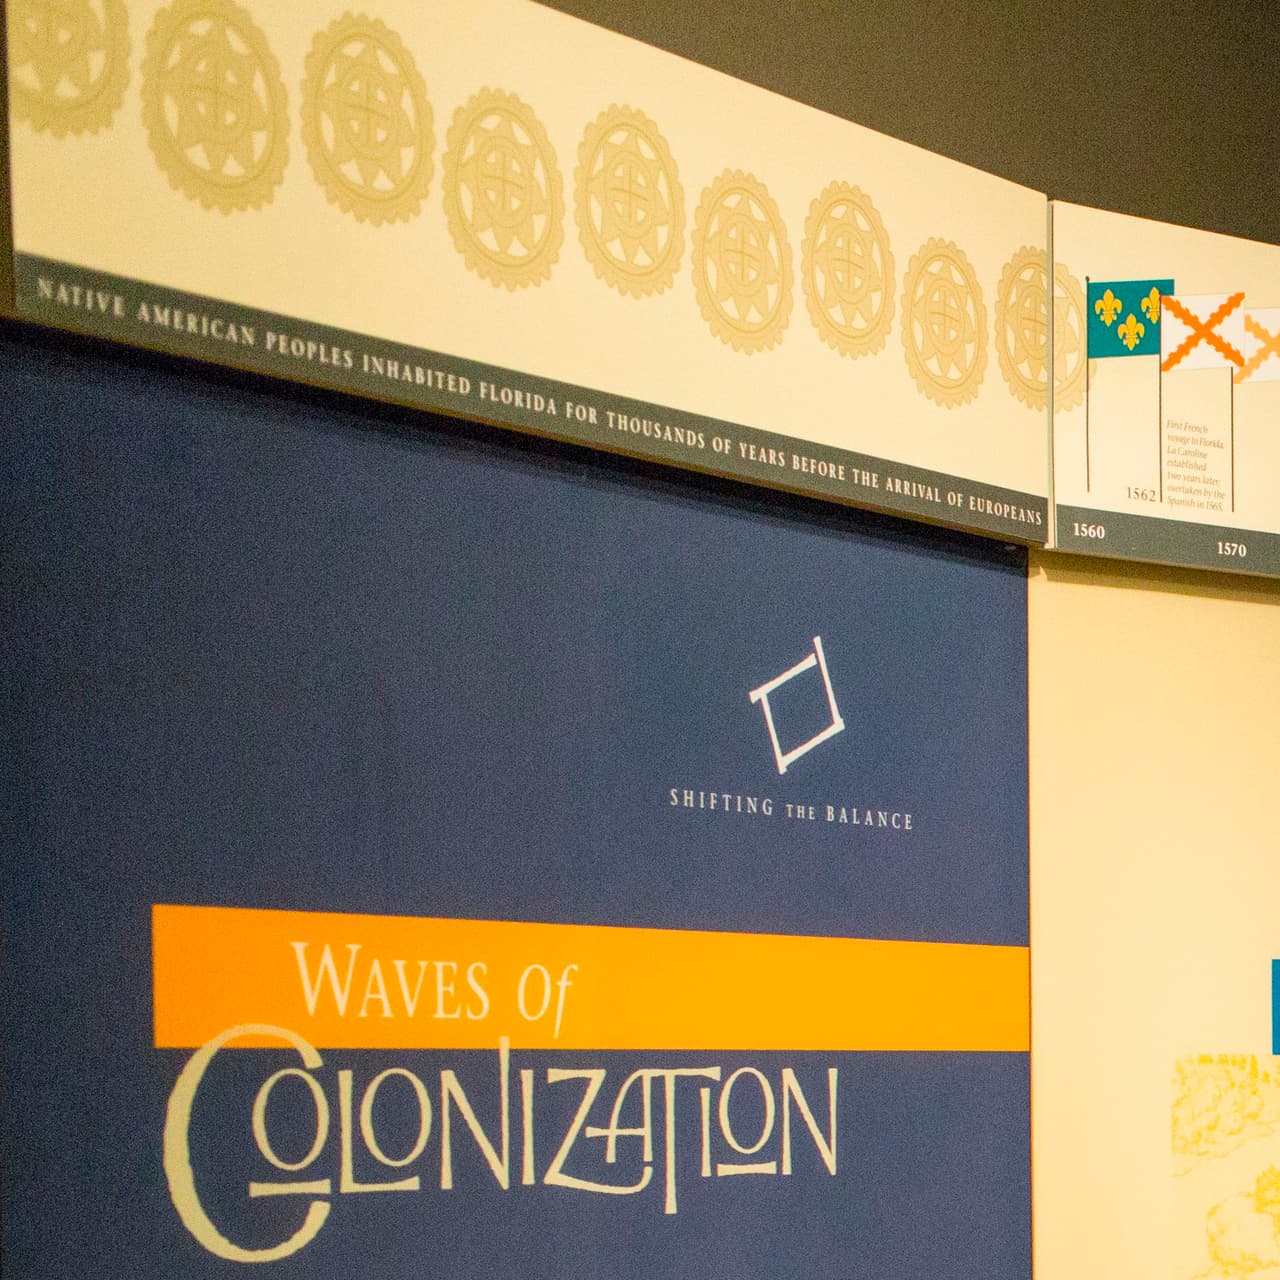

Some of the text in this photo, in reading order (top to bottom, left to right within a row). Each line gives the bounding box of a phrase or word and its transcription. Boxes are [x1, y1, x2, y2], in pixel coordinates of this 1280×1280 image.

[39, 276, 1042, 527] NATIVE AMERICAN PEOPLES INHABITED FLORIDA FOR THOUSANDS OF YEARS BEFORE THE ARRIVAL OF EUROPEANS
[1183, 422, 1209, 434] French
[1126, 486, 1156, 502] 1562
[1073, 521, 1105, 540] 1560
[1217, 541, 1247, 558] 1570
[670, 788, 913, 831] SHIFTING THE BALANCE
[290, 941, 490, 1020] WAVES
[163, 1023, 838, 1264] COLONIZATION
